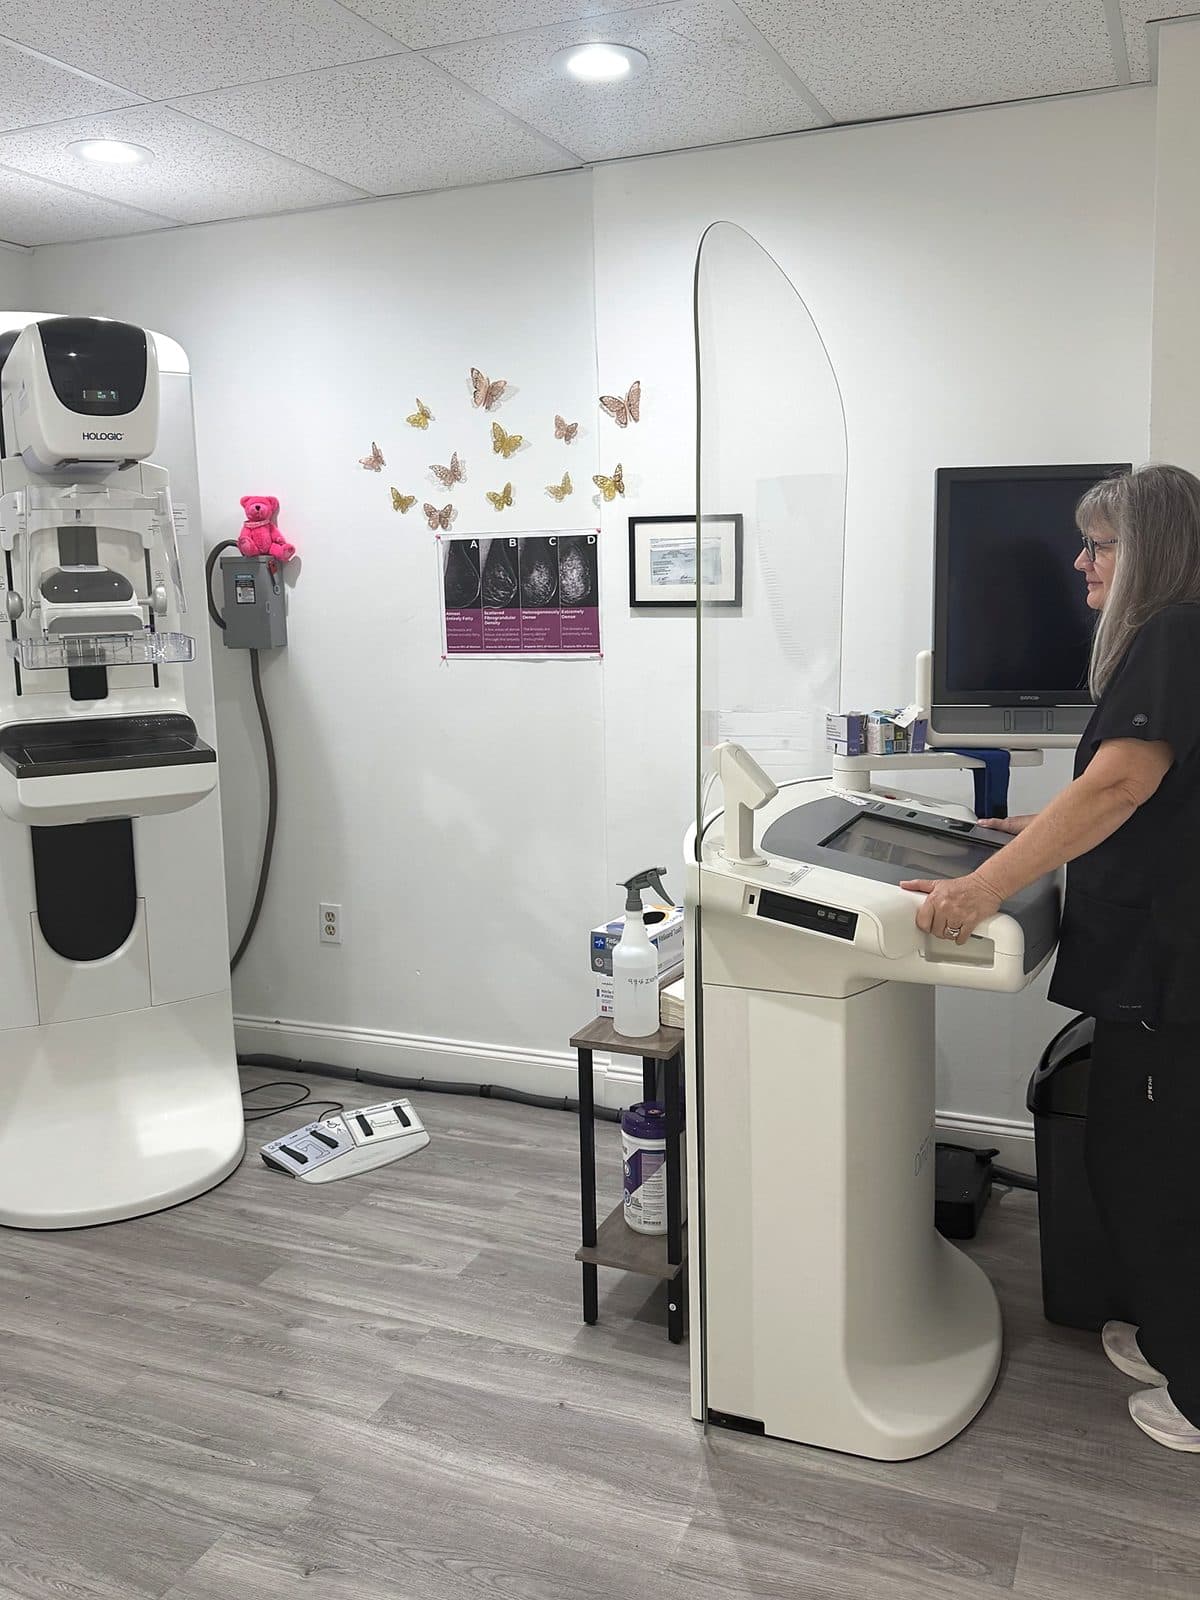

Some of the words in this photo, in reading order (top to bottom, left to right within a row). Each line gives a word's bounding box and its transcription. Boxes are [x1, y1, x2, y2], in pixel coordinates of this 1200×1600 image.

[82, 432, 123, 440] HOLOGIC
[470, 540, 479, 549] A
[509, 538, 517, 547] B
[548, 537, 557, 546] C
[587, 536, 596, 544] D
